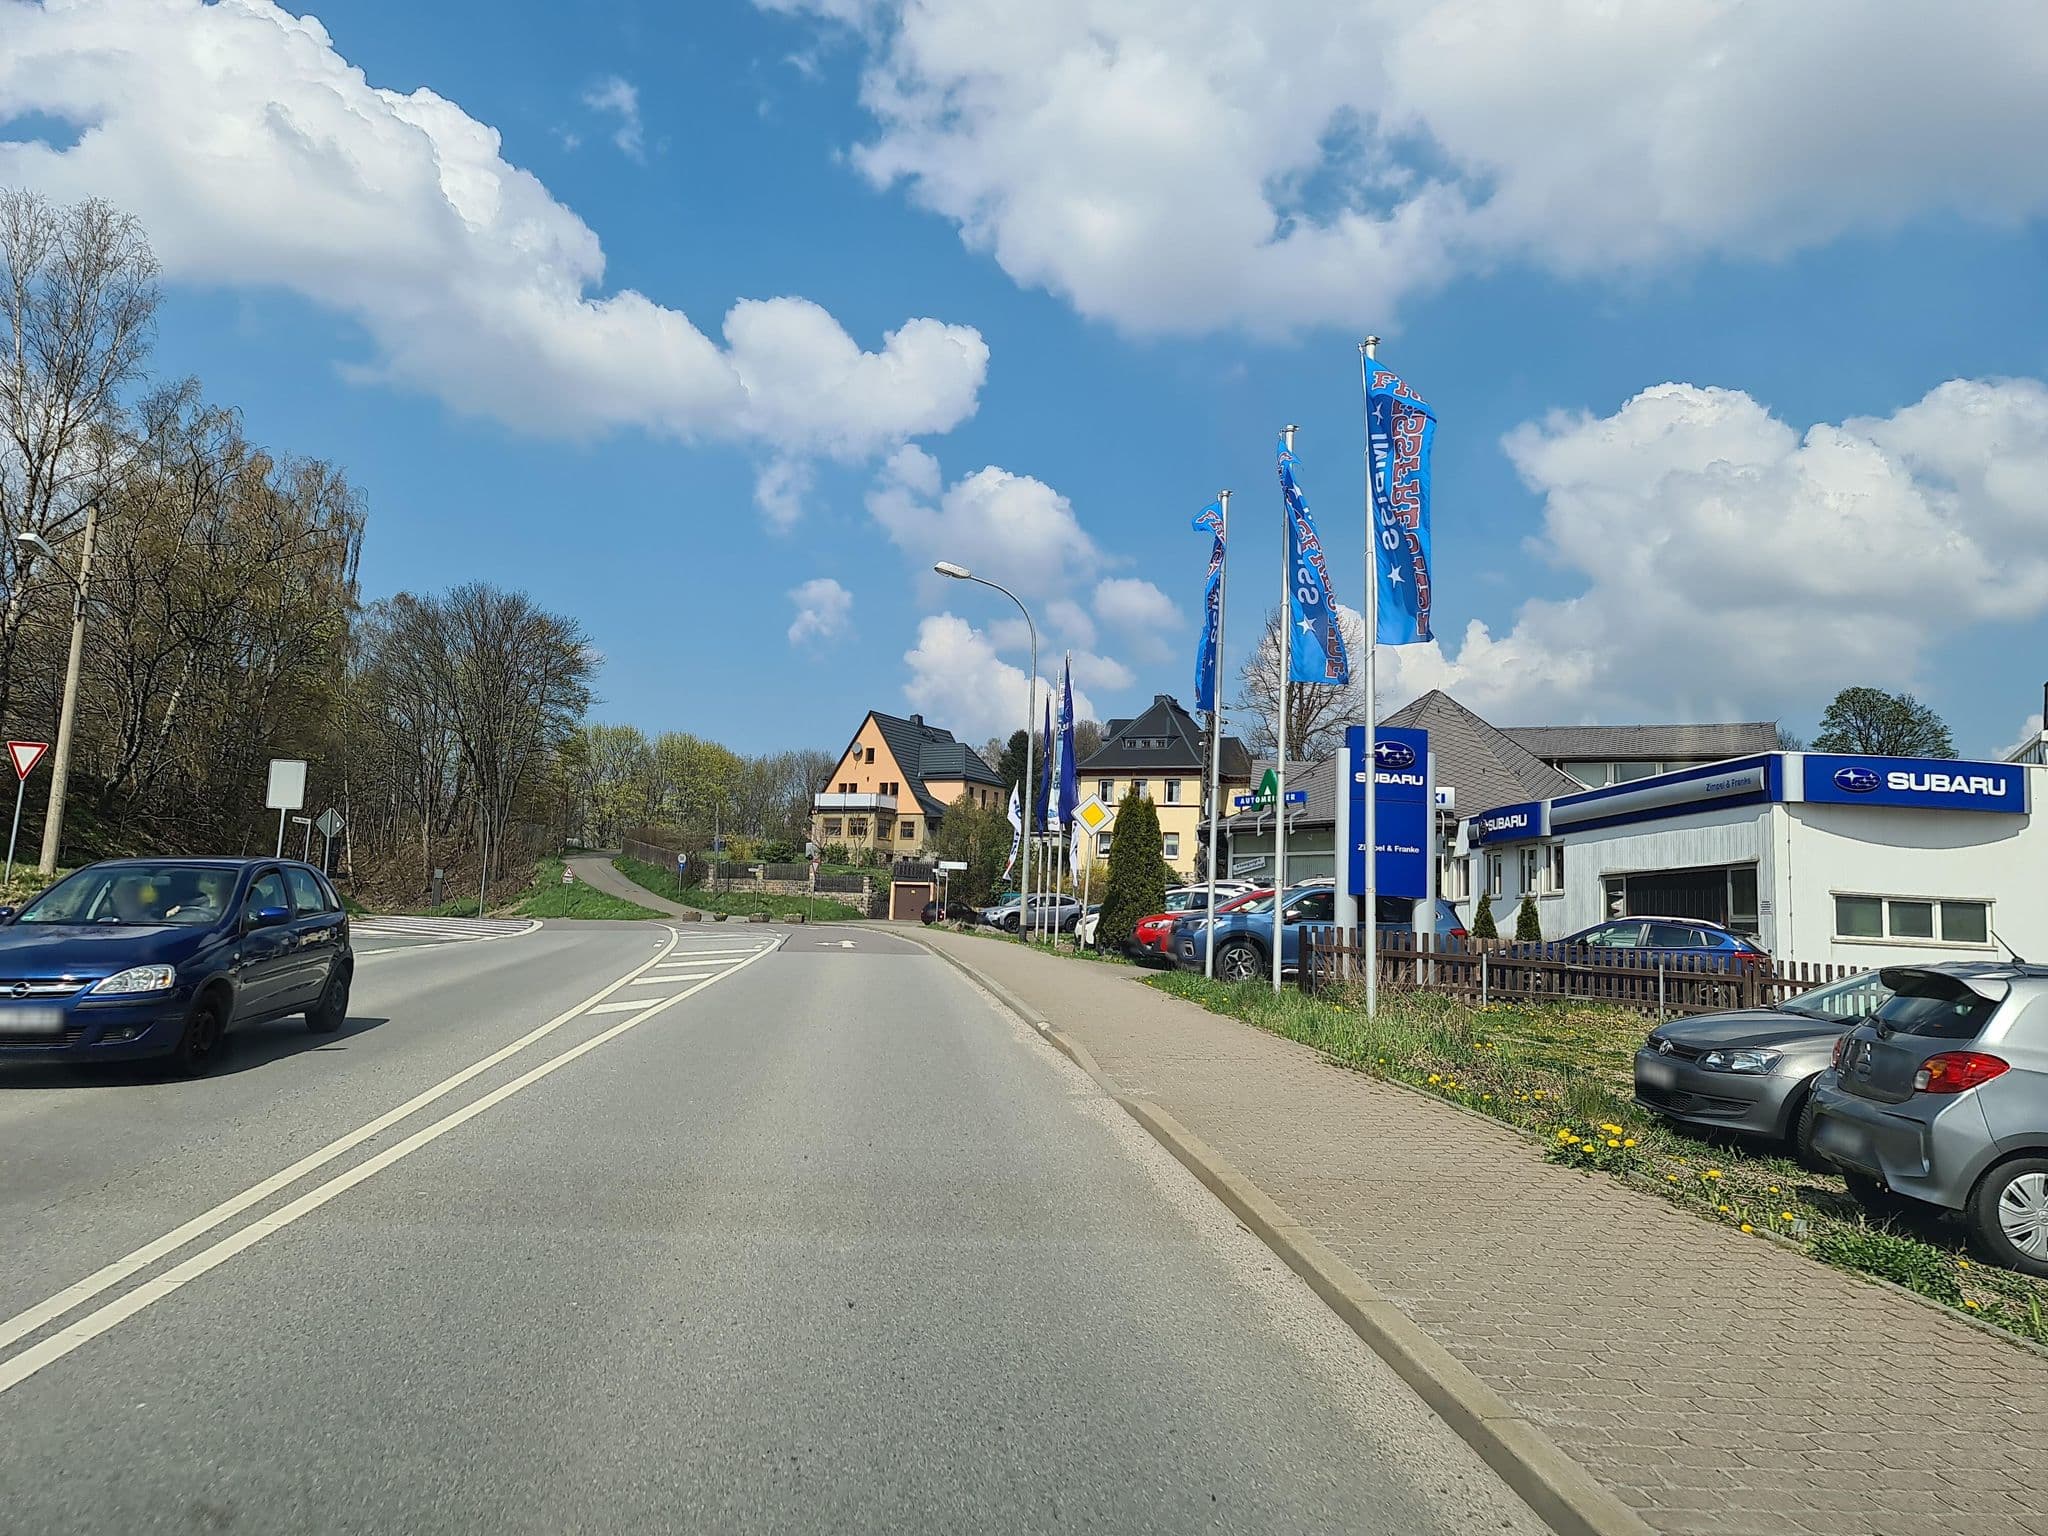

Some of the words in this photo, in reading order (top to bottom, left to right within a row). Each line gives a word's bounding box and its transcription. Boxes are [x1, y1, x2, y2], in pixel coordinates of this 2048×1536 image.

[1726, 780, 1731, 789] &
[1887, 772, 2006, 796] SUBARU
[1240, 793, 1296, 805] AUTOMEIER
[1488, 813, 1528, 832] SUBARU
[1358, 843, 1385, 852] Ziel
[1387, 844, 1393, 852] &
[1394, 845, 1420, 854] Franke
